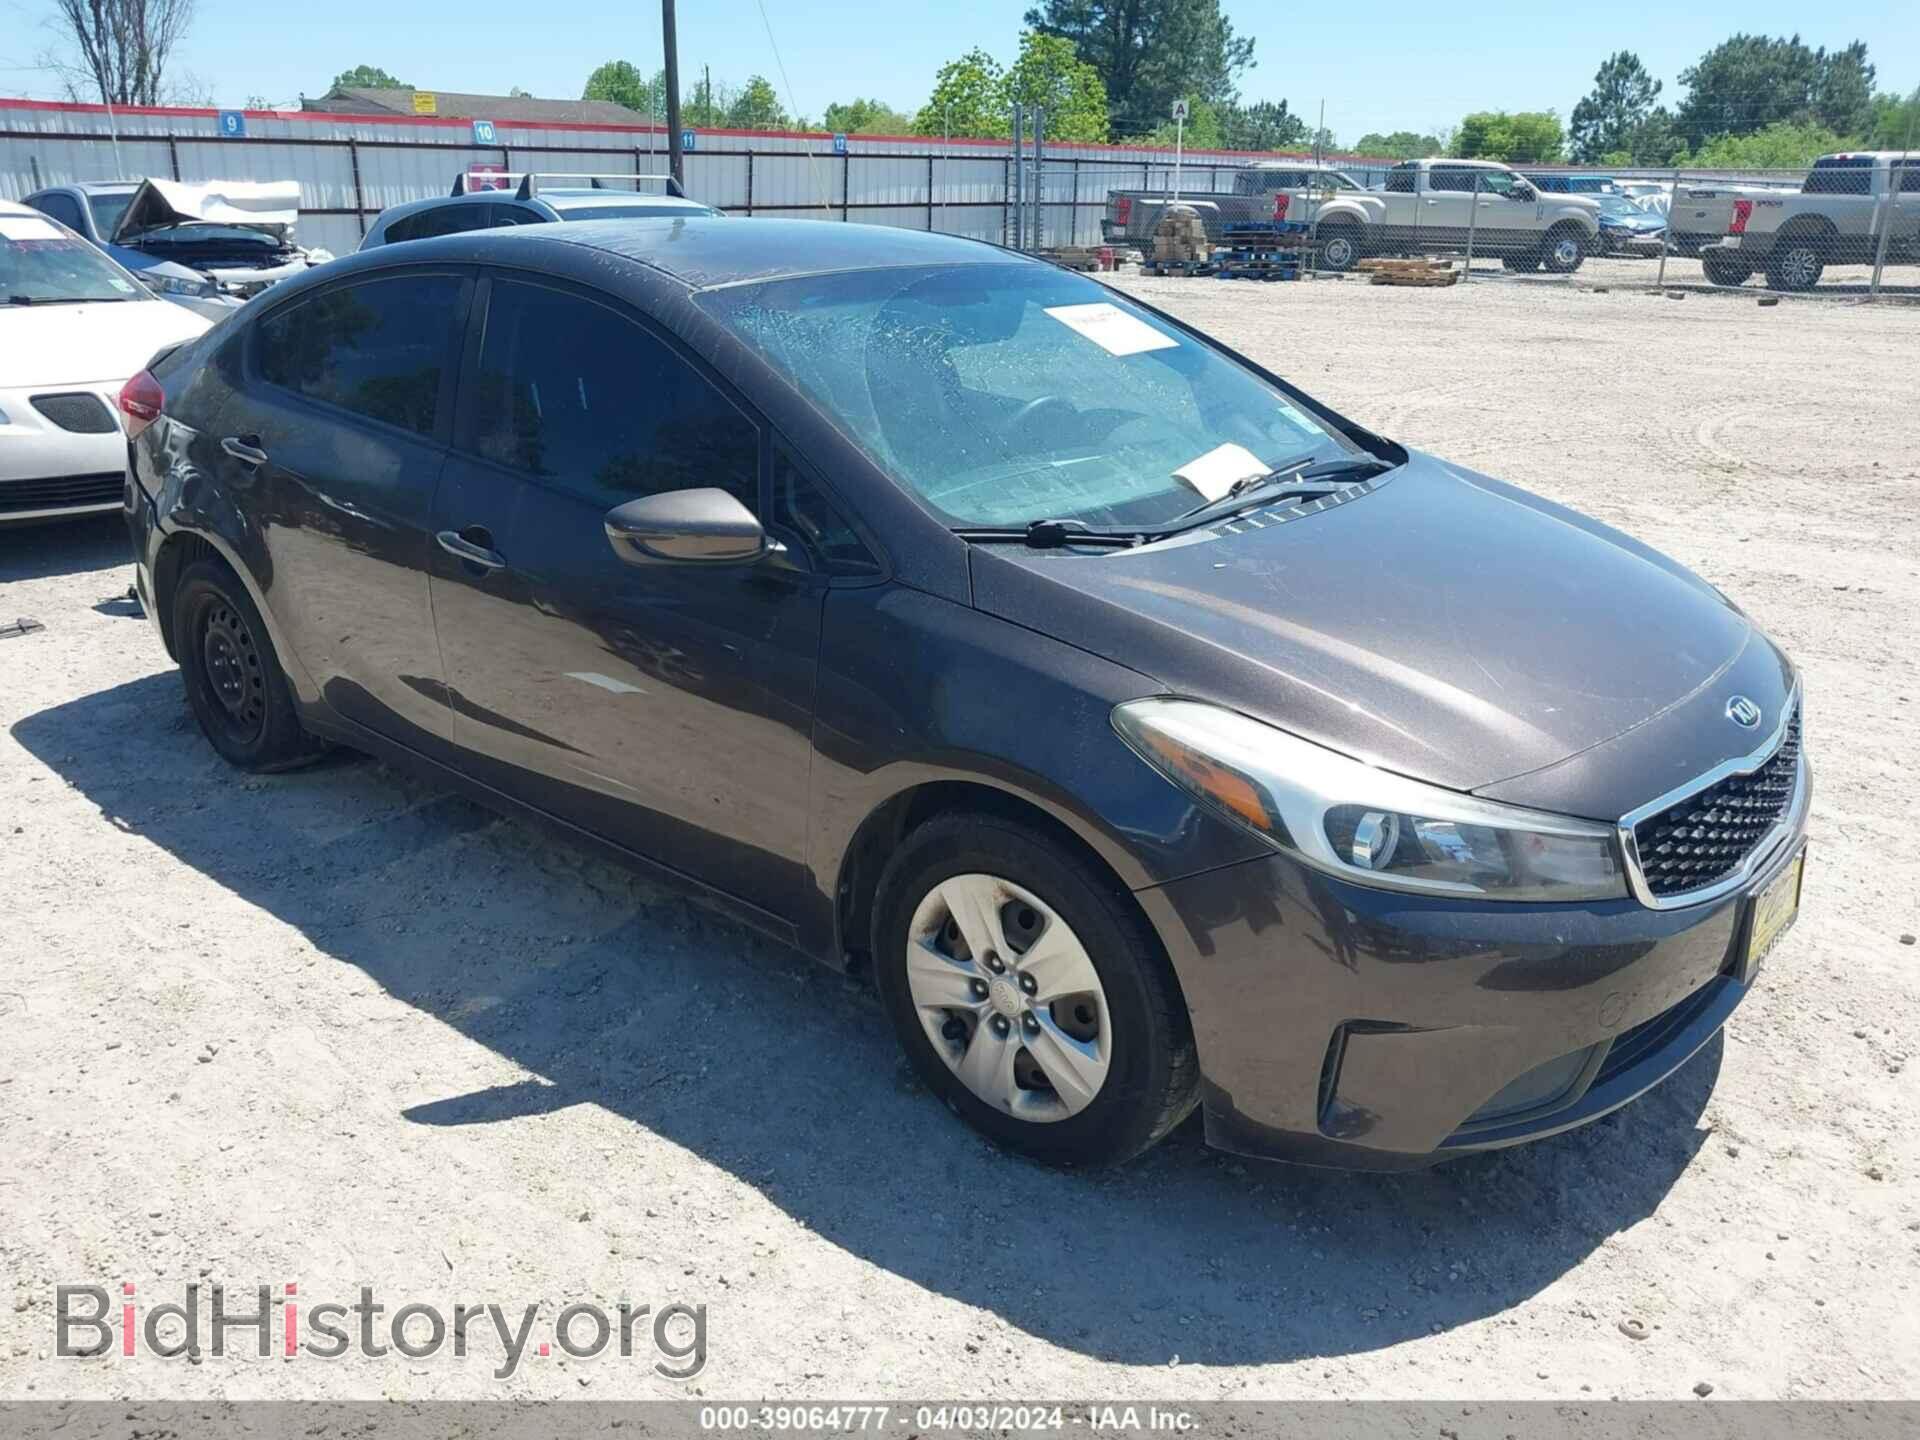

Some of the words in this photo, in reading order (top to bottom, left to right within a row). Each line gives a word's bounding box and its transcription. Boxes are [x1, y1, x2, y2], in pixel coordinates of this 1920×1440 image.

[1175, 103, 1186, 115] A
[227, 115, 238, 132] 9
[477, 125, 493, 140] 10
[683, 134, 694, 148] 11
[835, 139, 846, 151] 12
